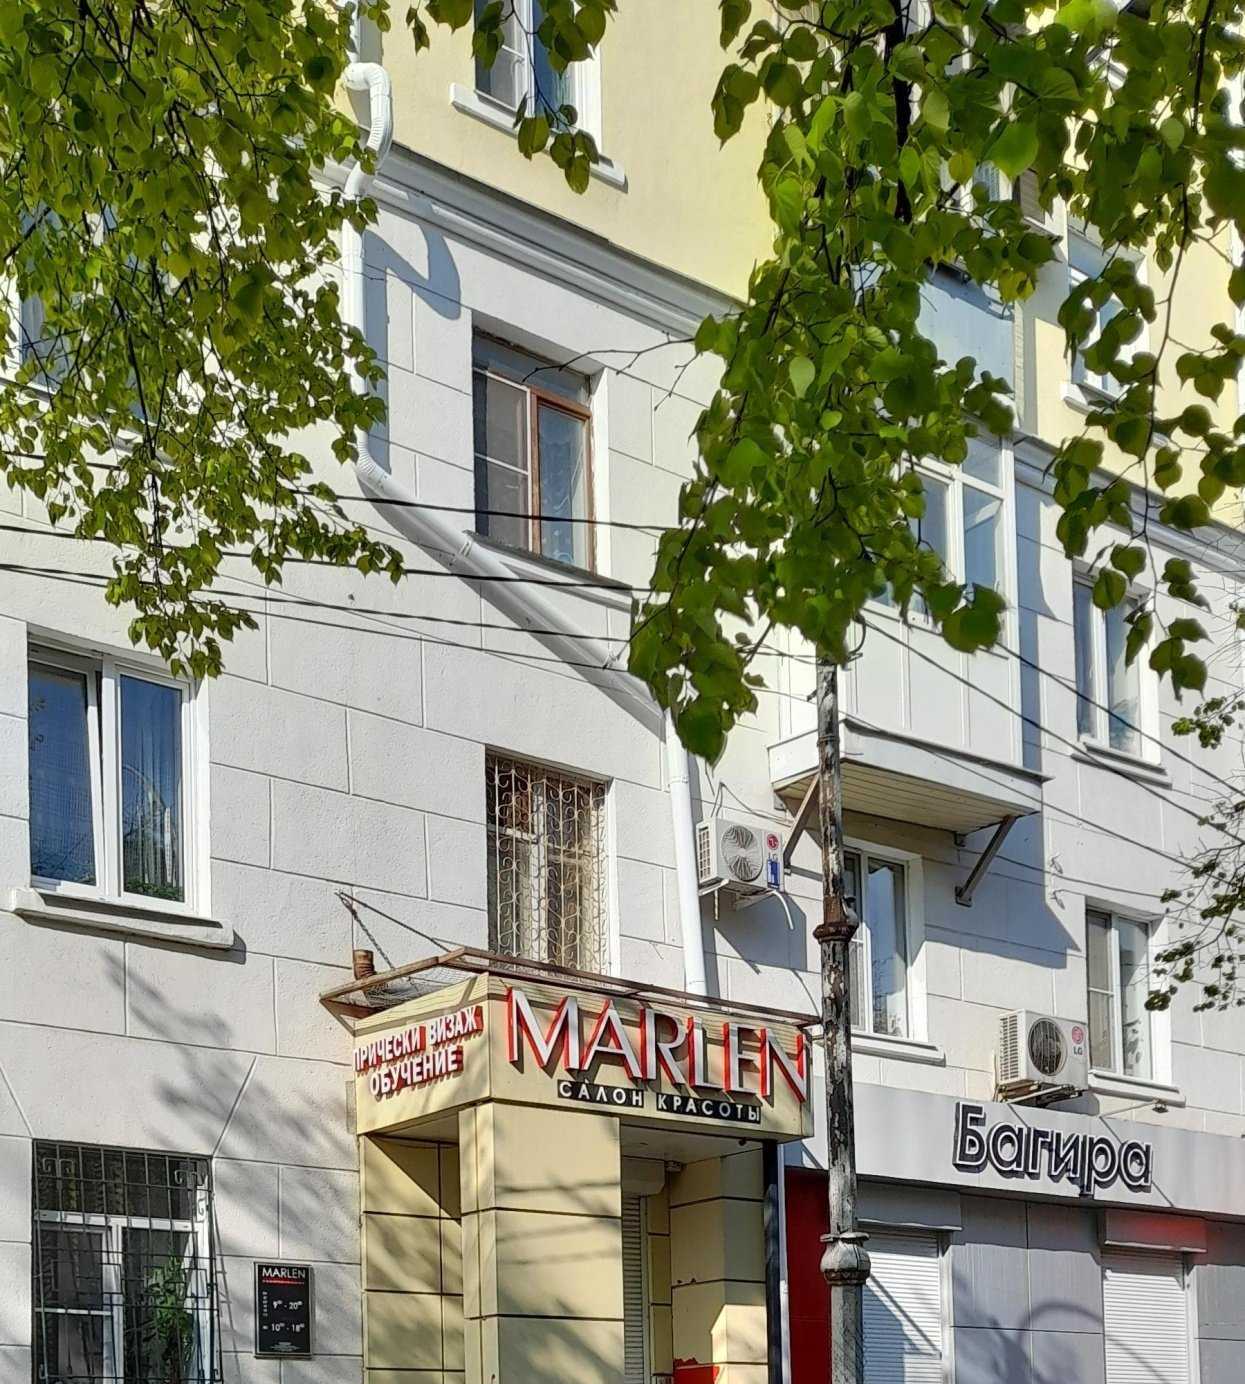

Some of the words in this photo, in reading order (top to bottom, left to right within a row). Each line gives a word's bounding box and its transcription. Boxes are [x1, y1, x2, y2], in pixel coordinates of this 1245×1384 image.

[353, 1027, 423, 1071] ПРИЧЕСКИ
[428, 1006, 482, 1045] ВИЗАЖ
[505, 986, 806, 1101] MARLEN
[1073, 1046, 1083, 1056] LG
[369, 1045, 462, 1096] ОБУЧЕНИЕ
[559, 1082, 643, 1107] САЛОН
[657, 1094, 760, 1122] КРАСОТЫ
[954, 1101, 1152, 1196] Багира
[262, 1267, 306, 1279] MARLEN
